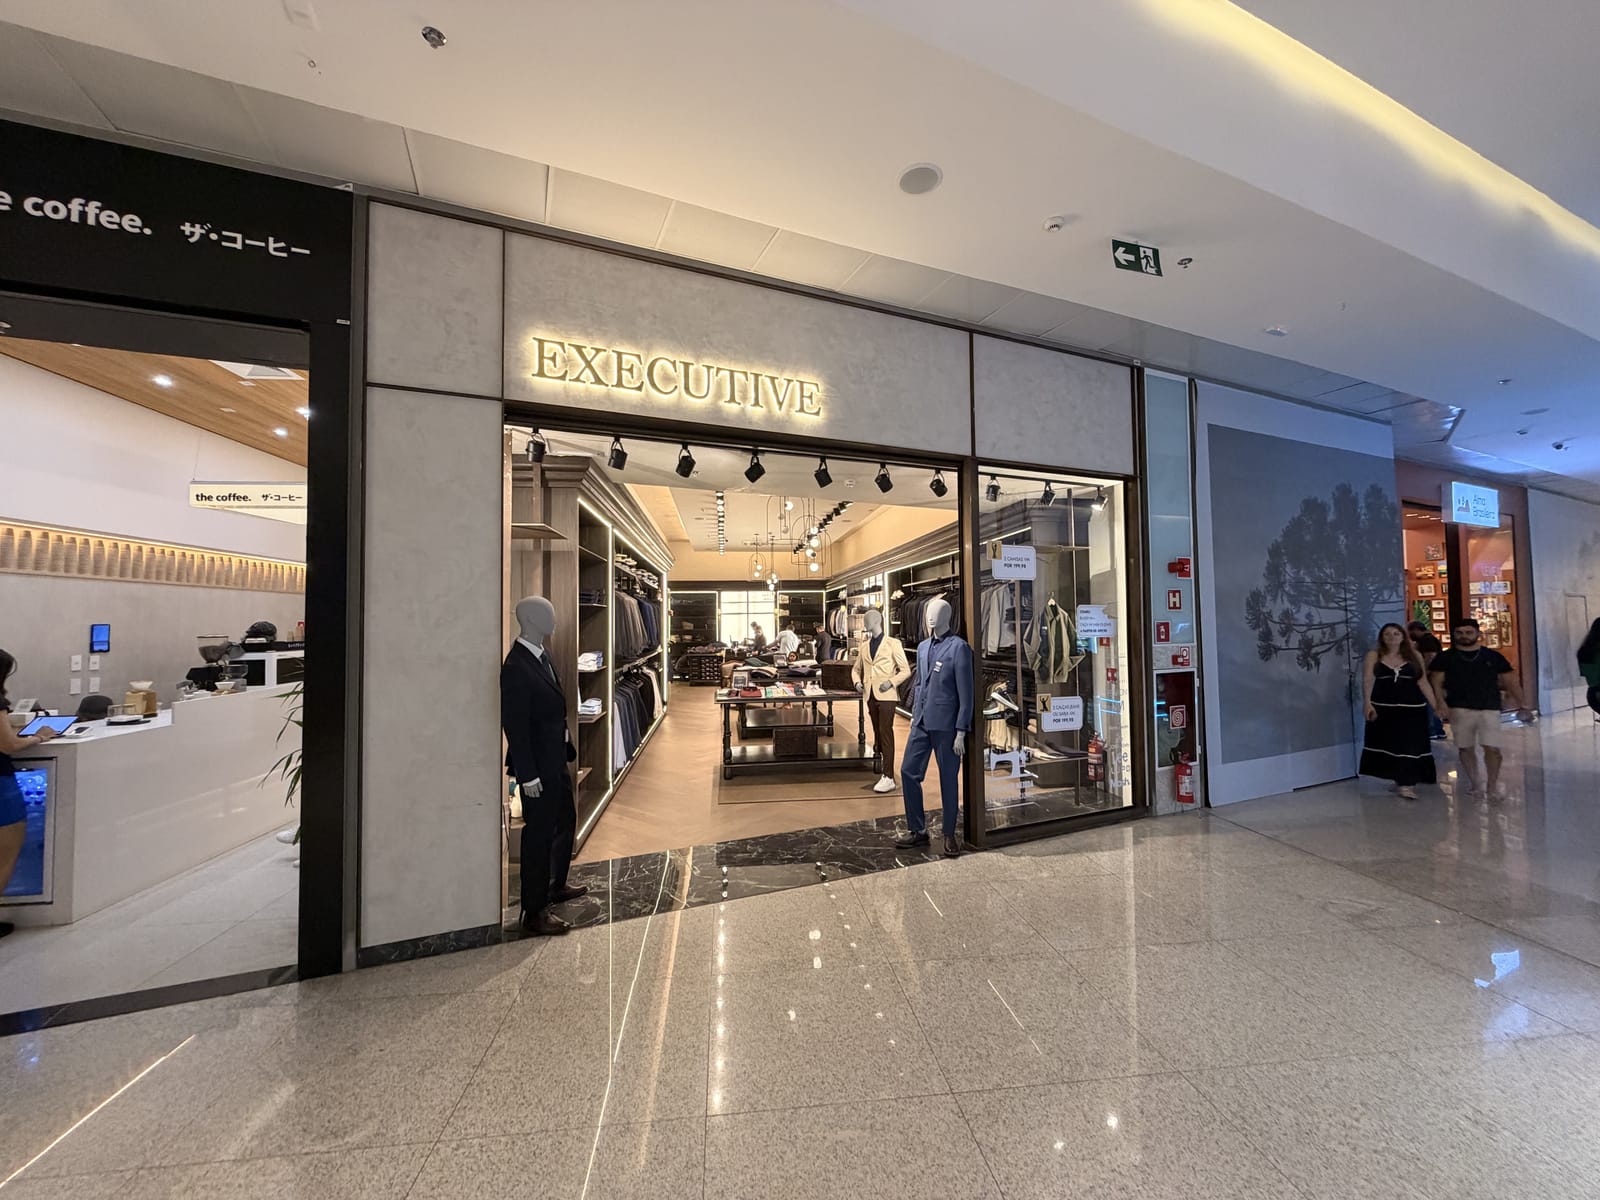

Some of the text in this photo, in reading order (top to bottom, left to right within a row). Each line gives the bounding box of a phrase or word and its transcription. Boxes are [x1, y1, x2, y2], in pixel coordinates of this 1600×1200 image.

[23, 196, 152, 236] coffee.
[179, 221, 310, 258] ザ・コーヒー
[531, 336, 822, 417] EXECUTIVE
[195, 492, 252, 502] the coffee.
[261, 493, 303, 502] ザ・コーヒー
[1169, 592, 1181, 609] H
